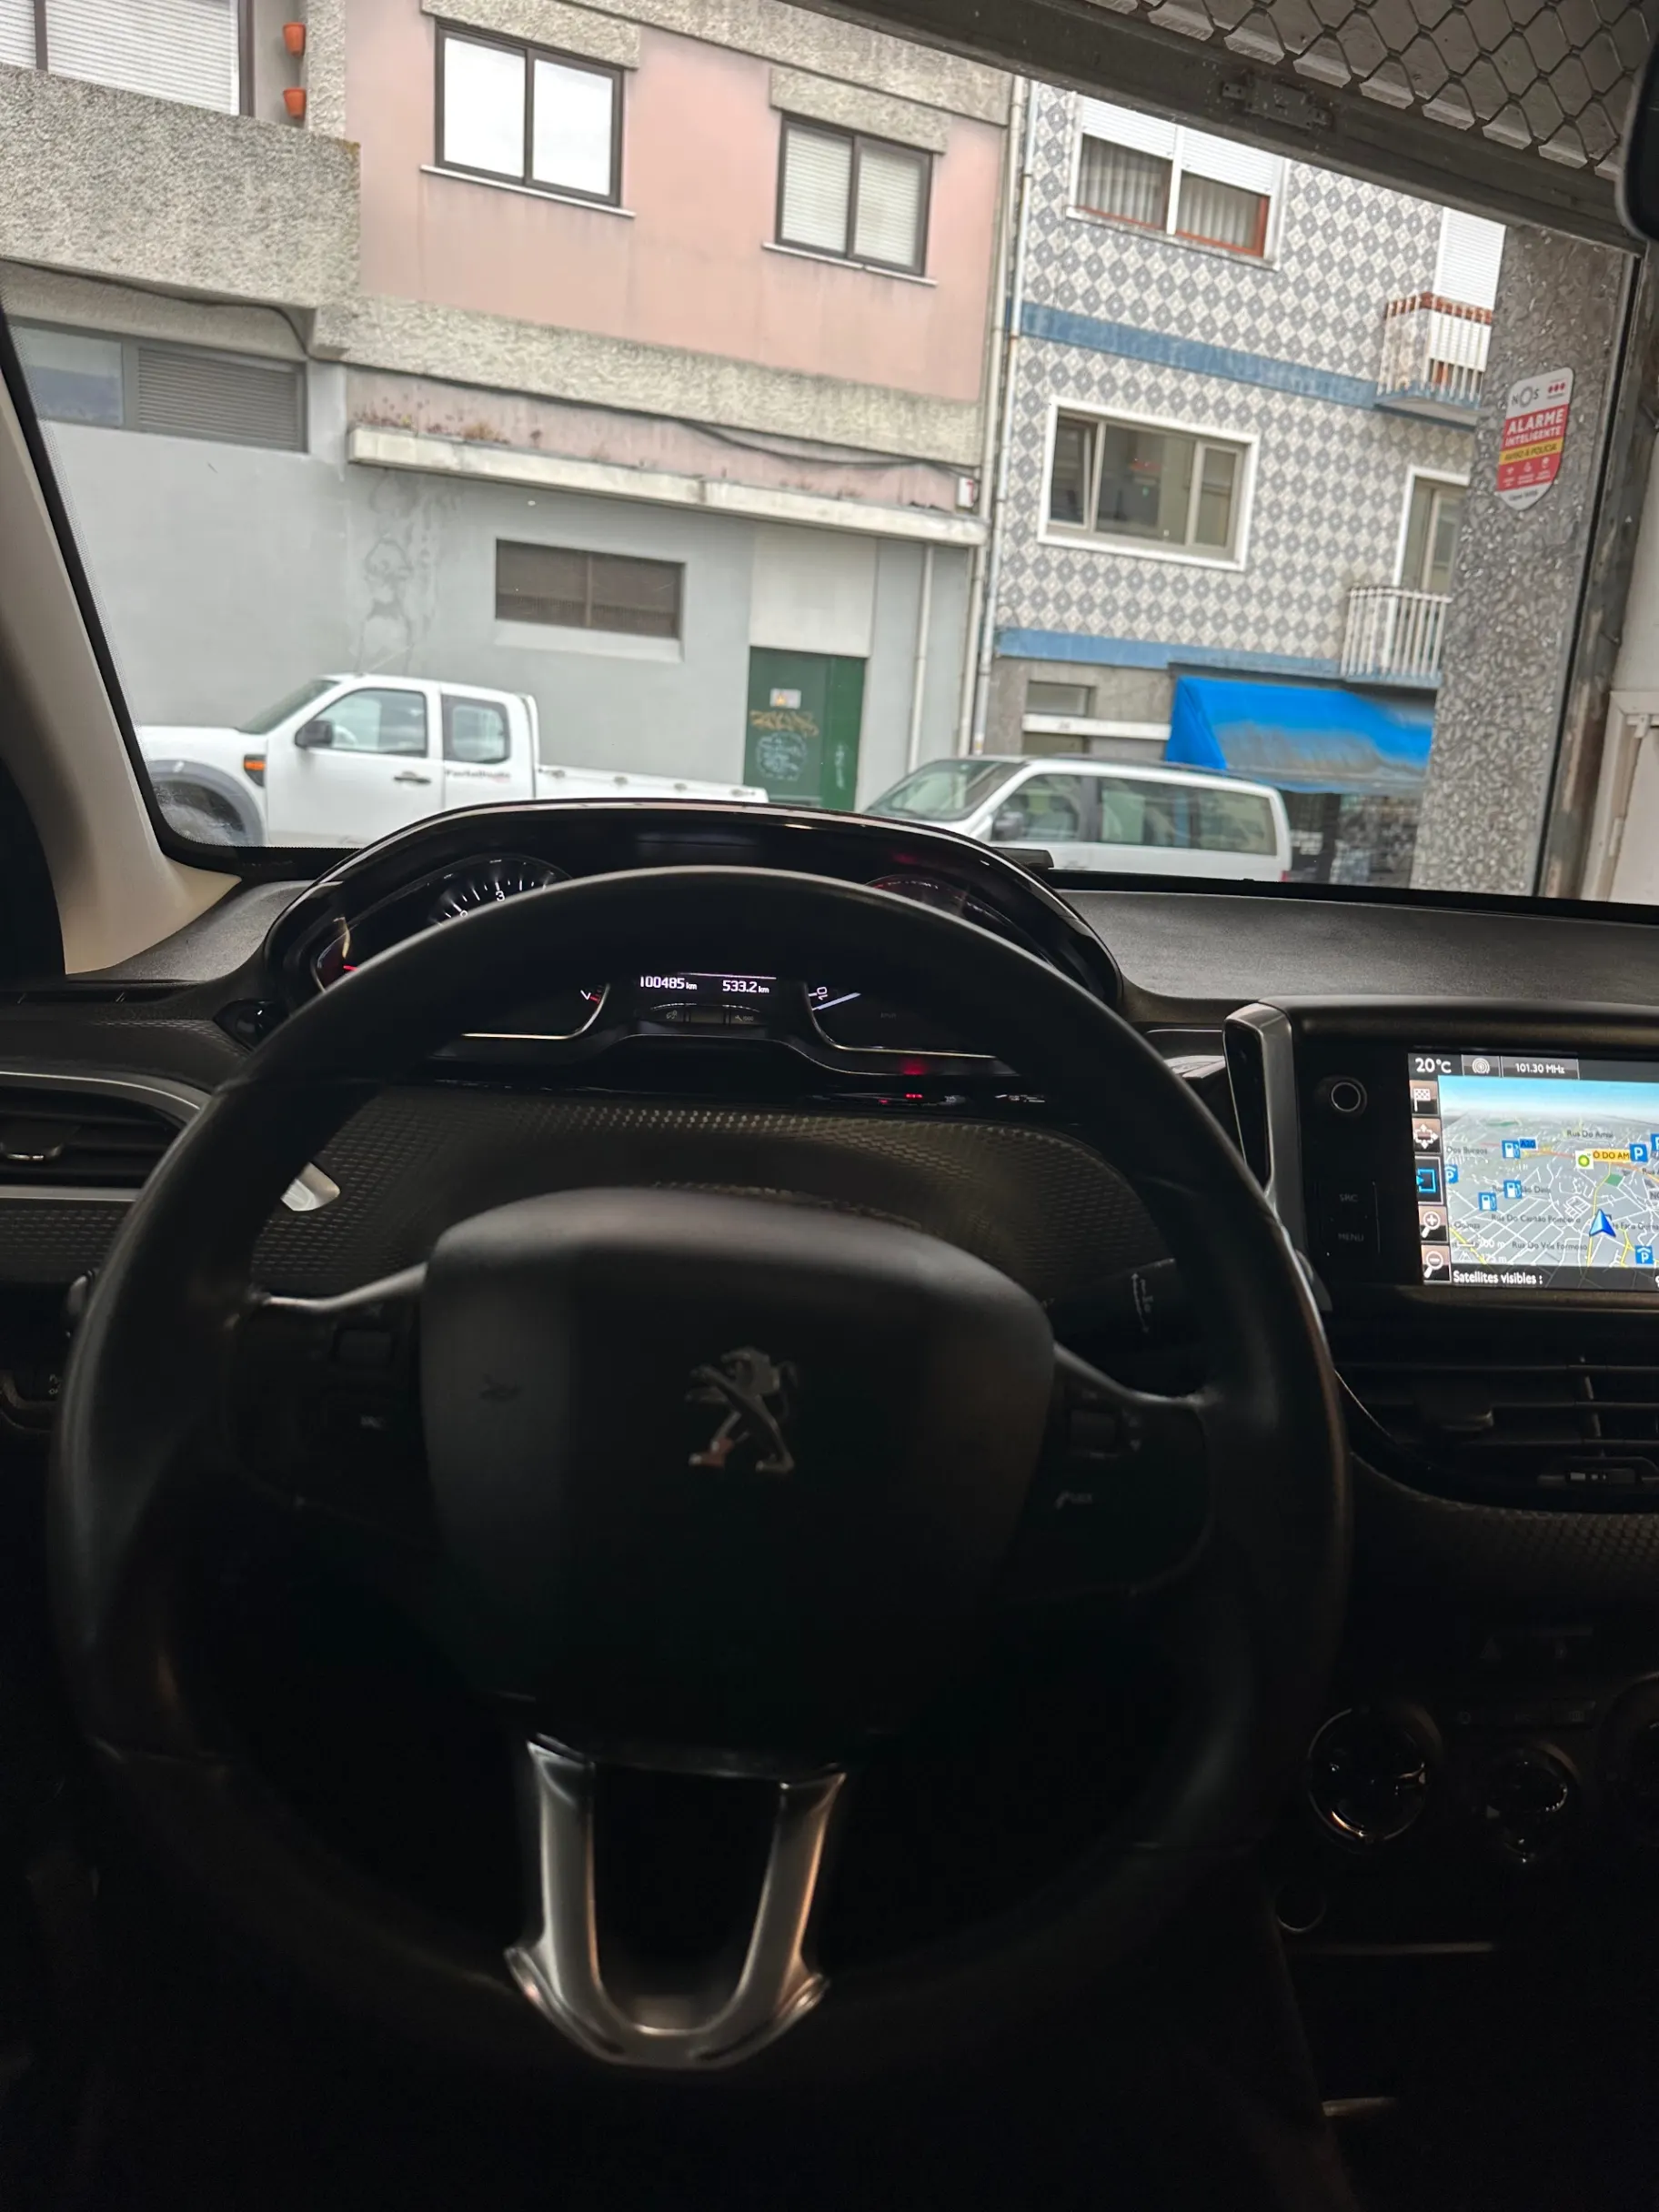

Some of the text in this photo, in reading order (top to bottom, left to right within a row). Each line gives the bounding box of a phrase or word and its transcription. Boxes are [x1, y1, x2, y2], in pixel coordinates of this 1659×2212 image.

[1511, 386, 1540, 408] NOS
[1506, 408, 1564, 436] ALARME
[1505, 426, 1562, 447] INTELIGENTE
[639, 975, 698, 990] 100485 km
[722, 980, 770, 994] 533.2 km
[1414, 1057, 1453, 1074] 20°C
[1514, 1062, 1565, 1074] 101.30 MHz
[1602, 1151, 1615, 1160] DO
[1617, 1151, 1629, 1160] AM
[1453, 1270, 1499, 1284] Satellites
[1500, 1271, 1537, 1285] visibles
